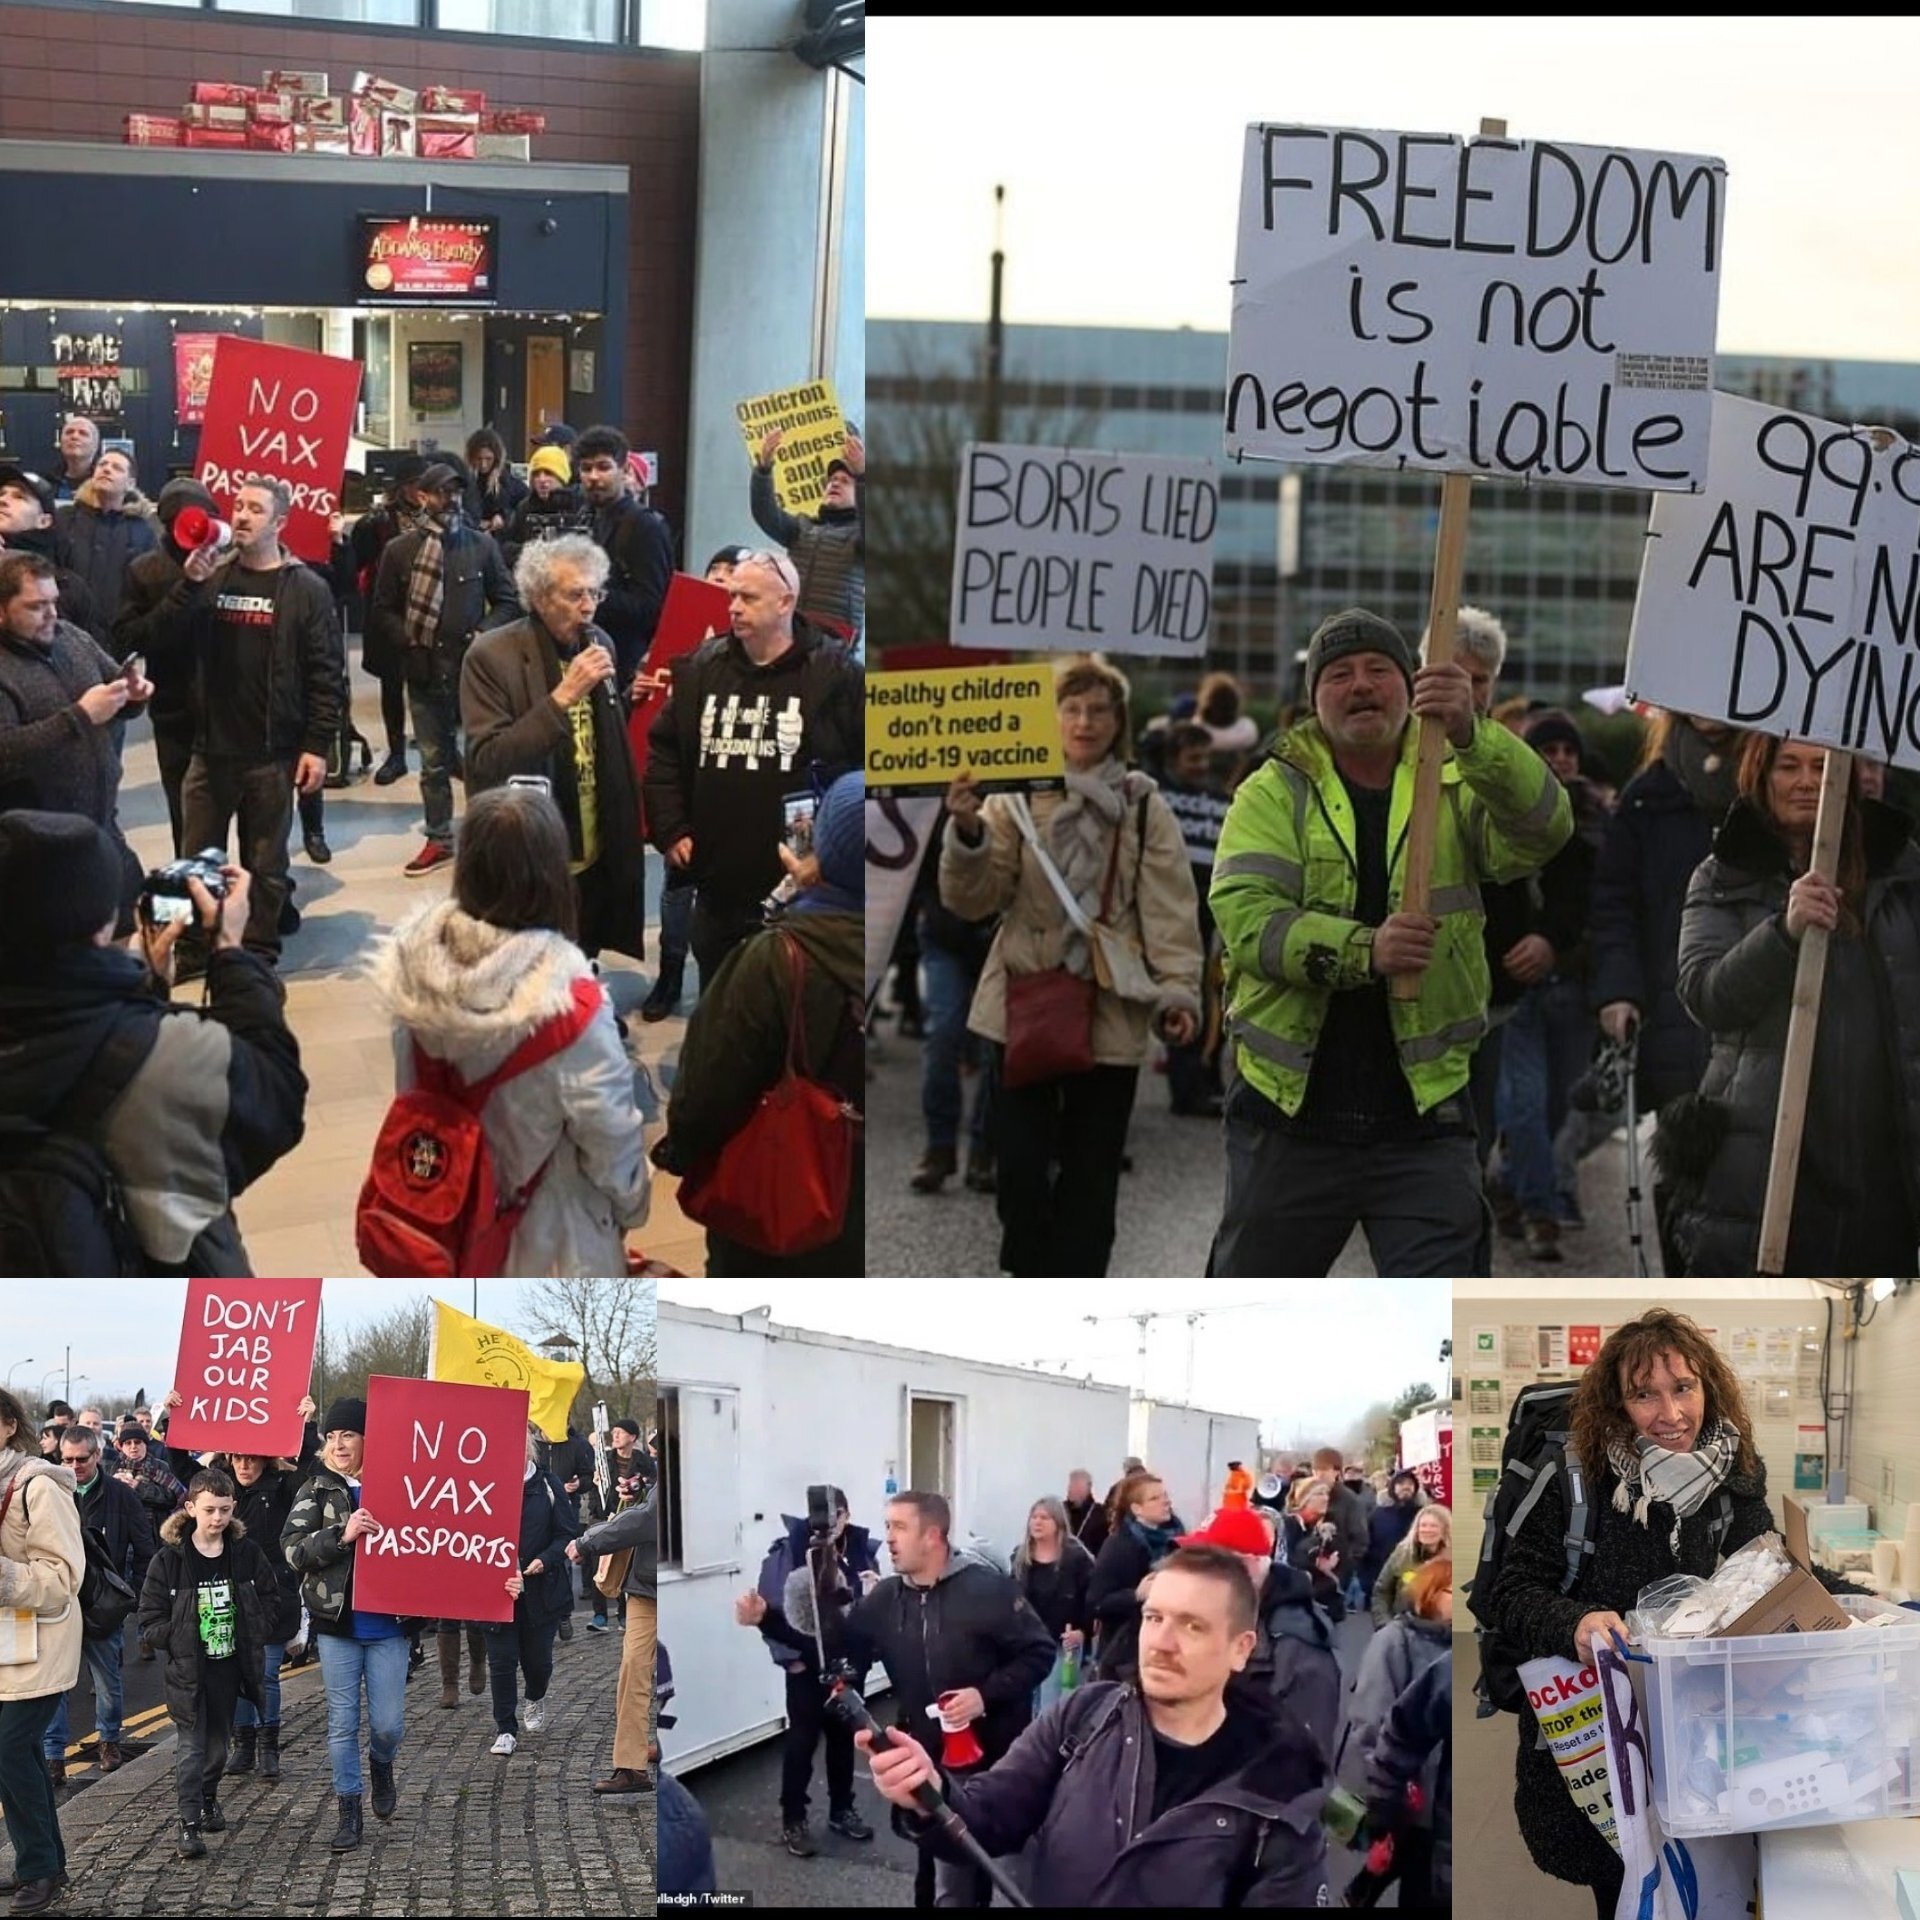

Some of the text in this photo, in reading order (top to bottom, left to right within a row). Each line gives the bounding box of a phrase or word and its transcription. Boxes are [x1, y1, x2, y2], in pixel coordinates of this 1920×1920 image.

[1262, 127, 1717, 272] FREEDOM
[1349, 266, 1616, 353] is not
[249, 377, 319, 422] NO
[736, 384, 827, 422] Omicron
[1226, 361, 1690, 479] negotiable
[239, 424, 323, 469] VAX
[783, 455, 825, 484] and
[967, 453, 1217, 544] BORIS LIED
[1688, 501, 1920, 646] ARE N
[959, 548, 1209, 642] PEOPLE DIED
[865, 677, 1040, 707] Healthy children
[888, 710, 1021, 738] don't need a
[869, 741, 1049, 771] Covid-19 vaccine
[203, 1293, 306, 1333] DON'T
[209, 1333, 272, 1364] JAB
[203, 1365, 270, 1391] OUR
[189, 1396, 270, 1425] KIDS
[413, 1420, 488, 1464] NO
[403, 1475, 496, 1516] VAX
[365, 1524, 516, 1569] PASSPORTS
[1541, 1714, 1575, 1736] STOP
[1583, 1728, 1598, 1742] as
